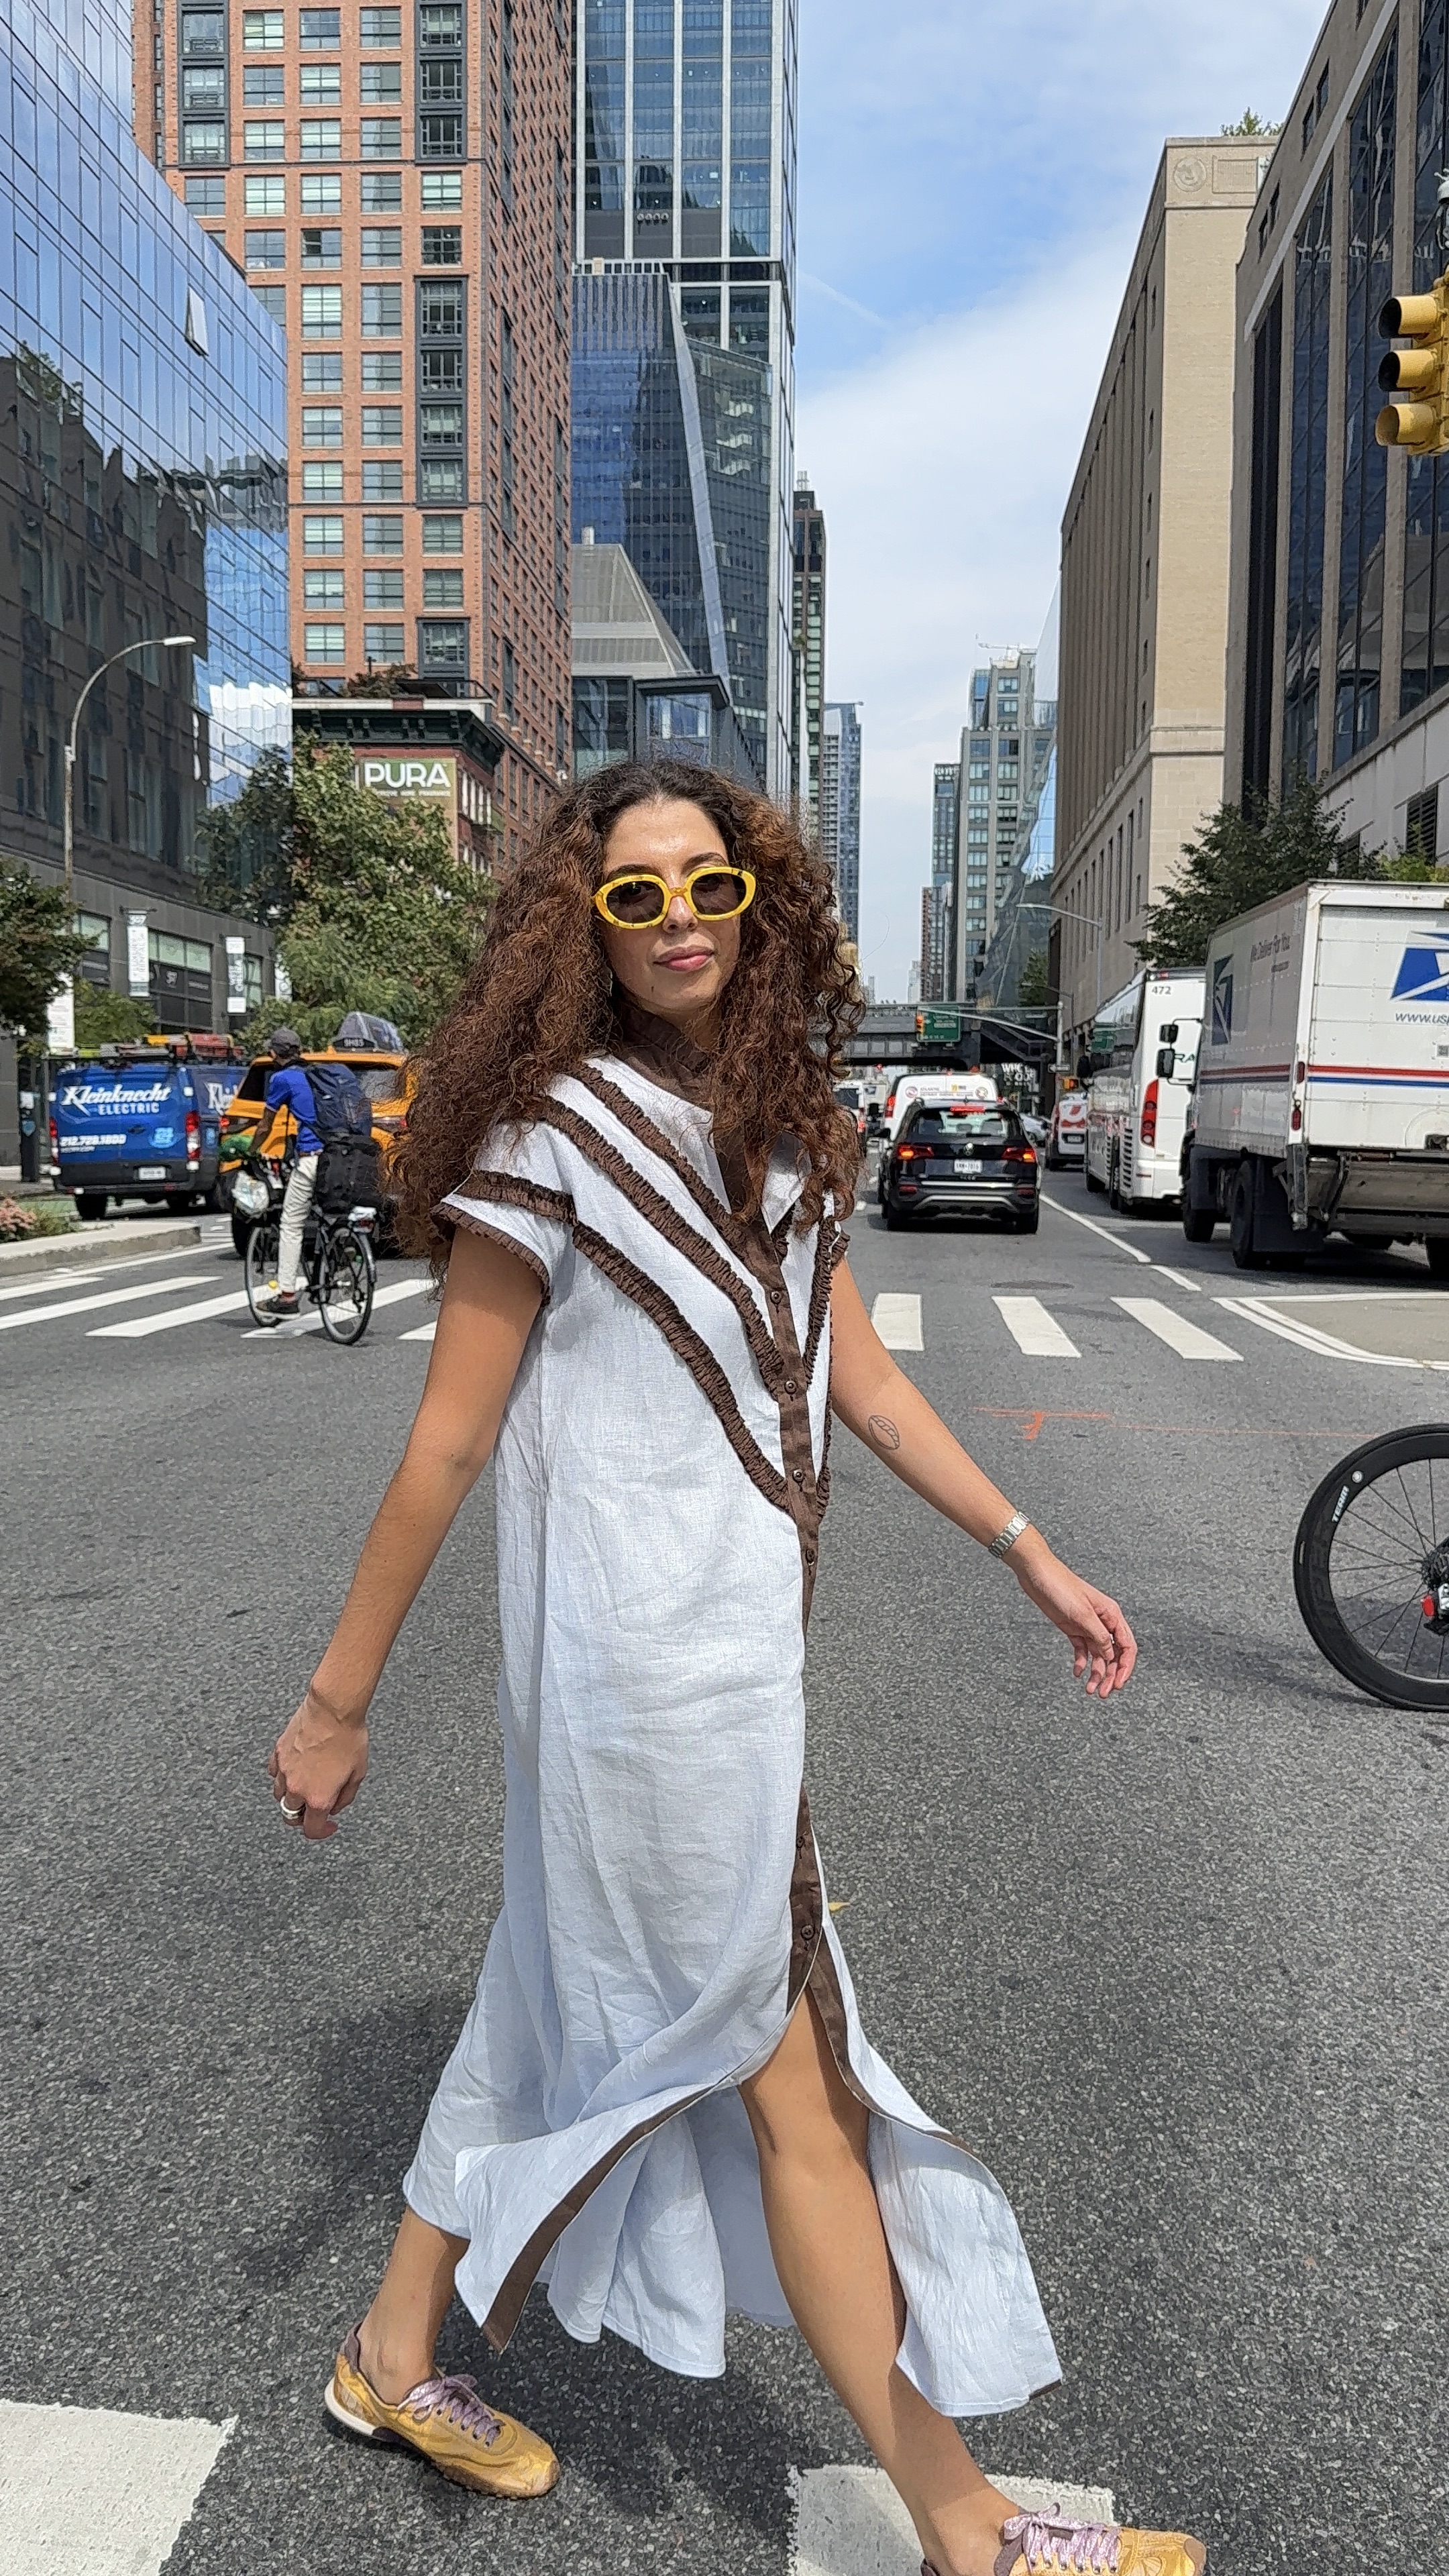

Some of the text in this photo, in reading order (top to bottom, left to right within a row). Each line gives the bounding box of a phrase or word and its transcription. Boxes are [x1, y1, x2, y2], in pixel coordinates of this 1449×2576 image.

[364, 761, 451, 788] PURA
[1151, 986, 1171, 995] 472
[61, 1082, 172, 1116] Kleinknecht
[97, 1102, 160, 1115] ELECTRIC
